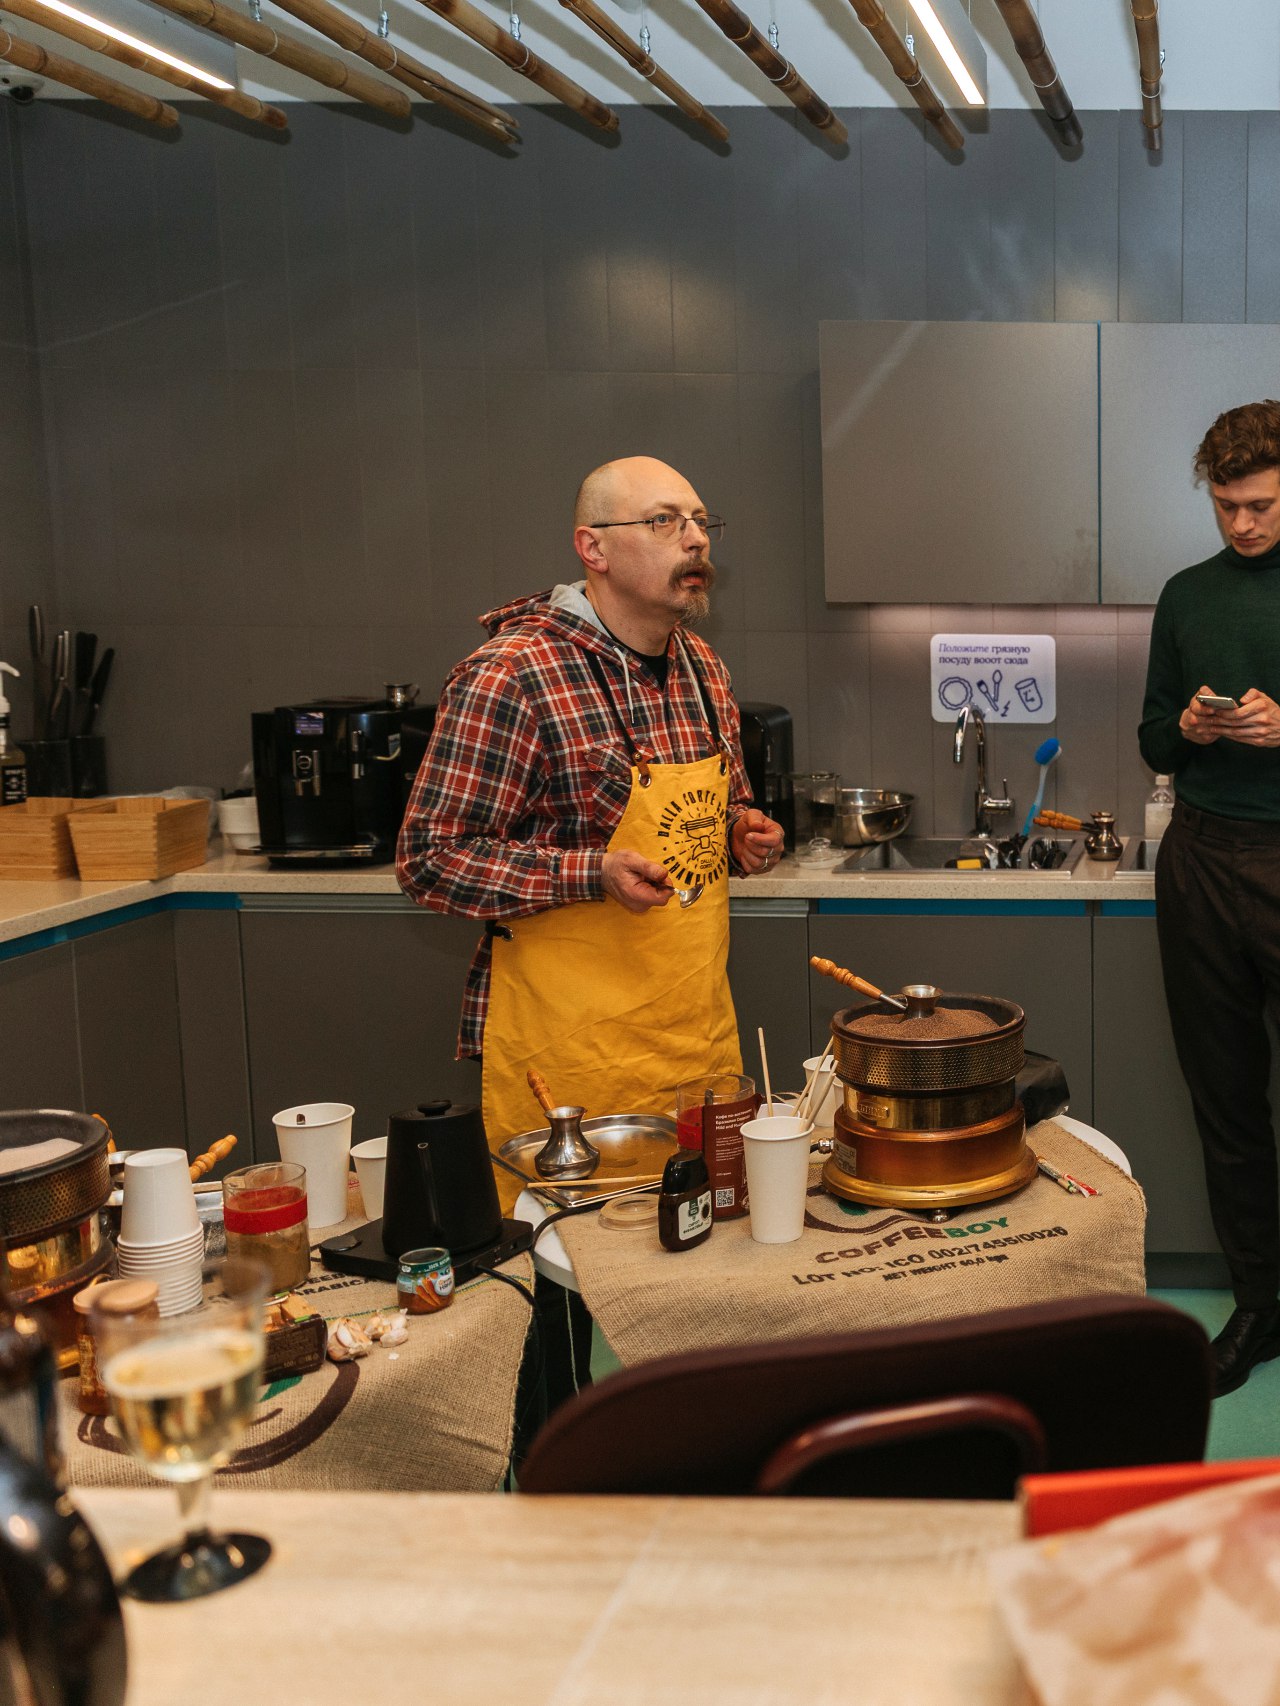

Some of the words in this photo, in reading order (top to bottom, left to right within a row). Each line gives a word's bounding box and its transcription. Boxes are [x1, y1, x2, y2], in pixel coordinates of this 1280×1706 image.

[939, 643, 989, 653] Положите
[991, 645, 1031, 655] грязную
[939, 657, 972, 666] посуду
[974, 656, 1002, 665] вооот
[1004, 657, 1029, 665] сюда
[658, 801, 683, 837] DALLA
[683, 789, 717, 806] CORTE
[792, 1273, 836, 1285] LOT
[884, 1254, 925, 1268] ICO
[927, 1226, 1069, 1259] 002/7455/0026
[815, 1216, 1009, 1264] COFFEEBOY
[882, 1271, 907, 1281] NET
[909, 1261, 957, 1276] WEIGHT
